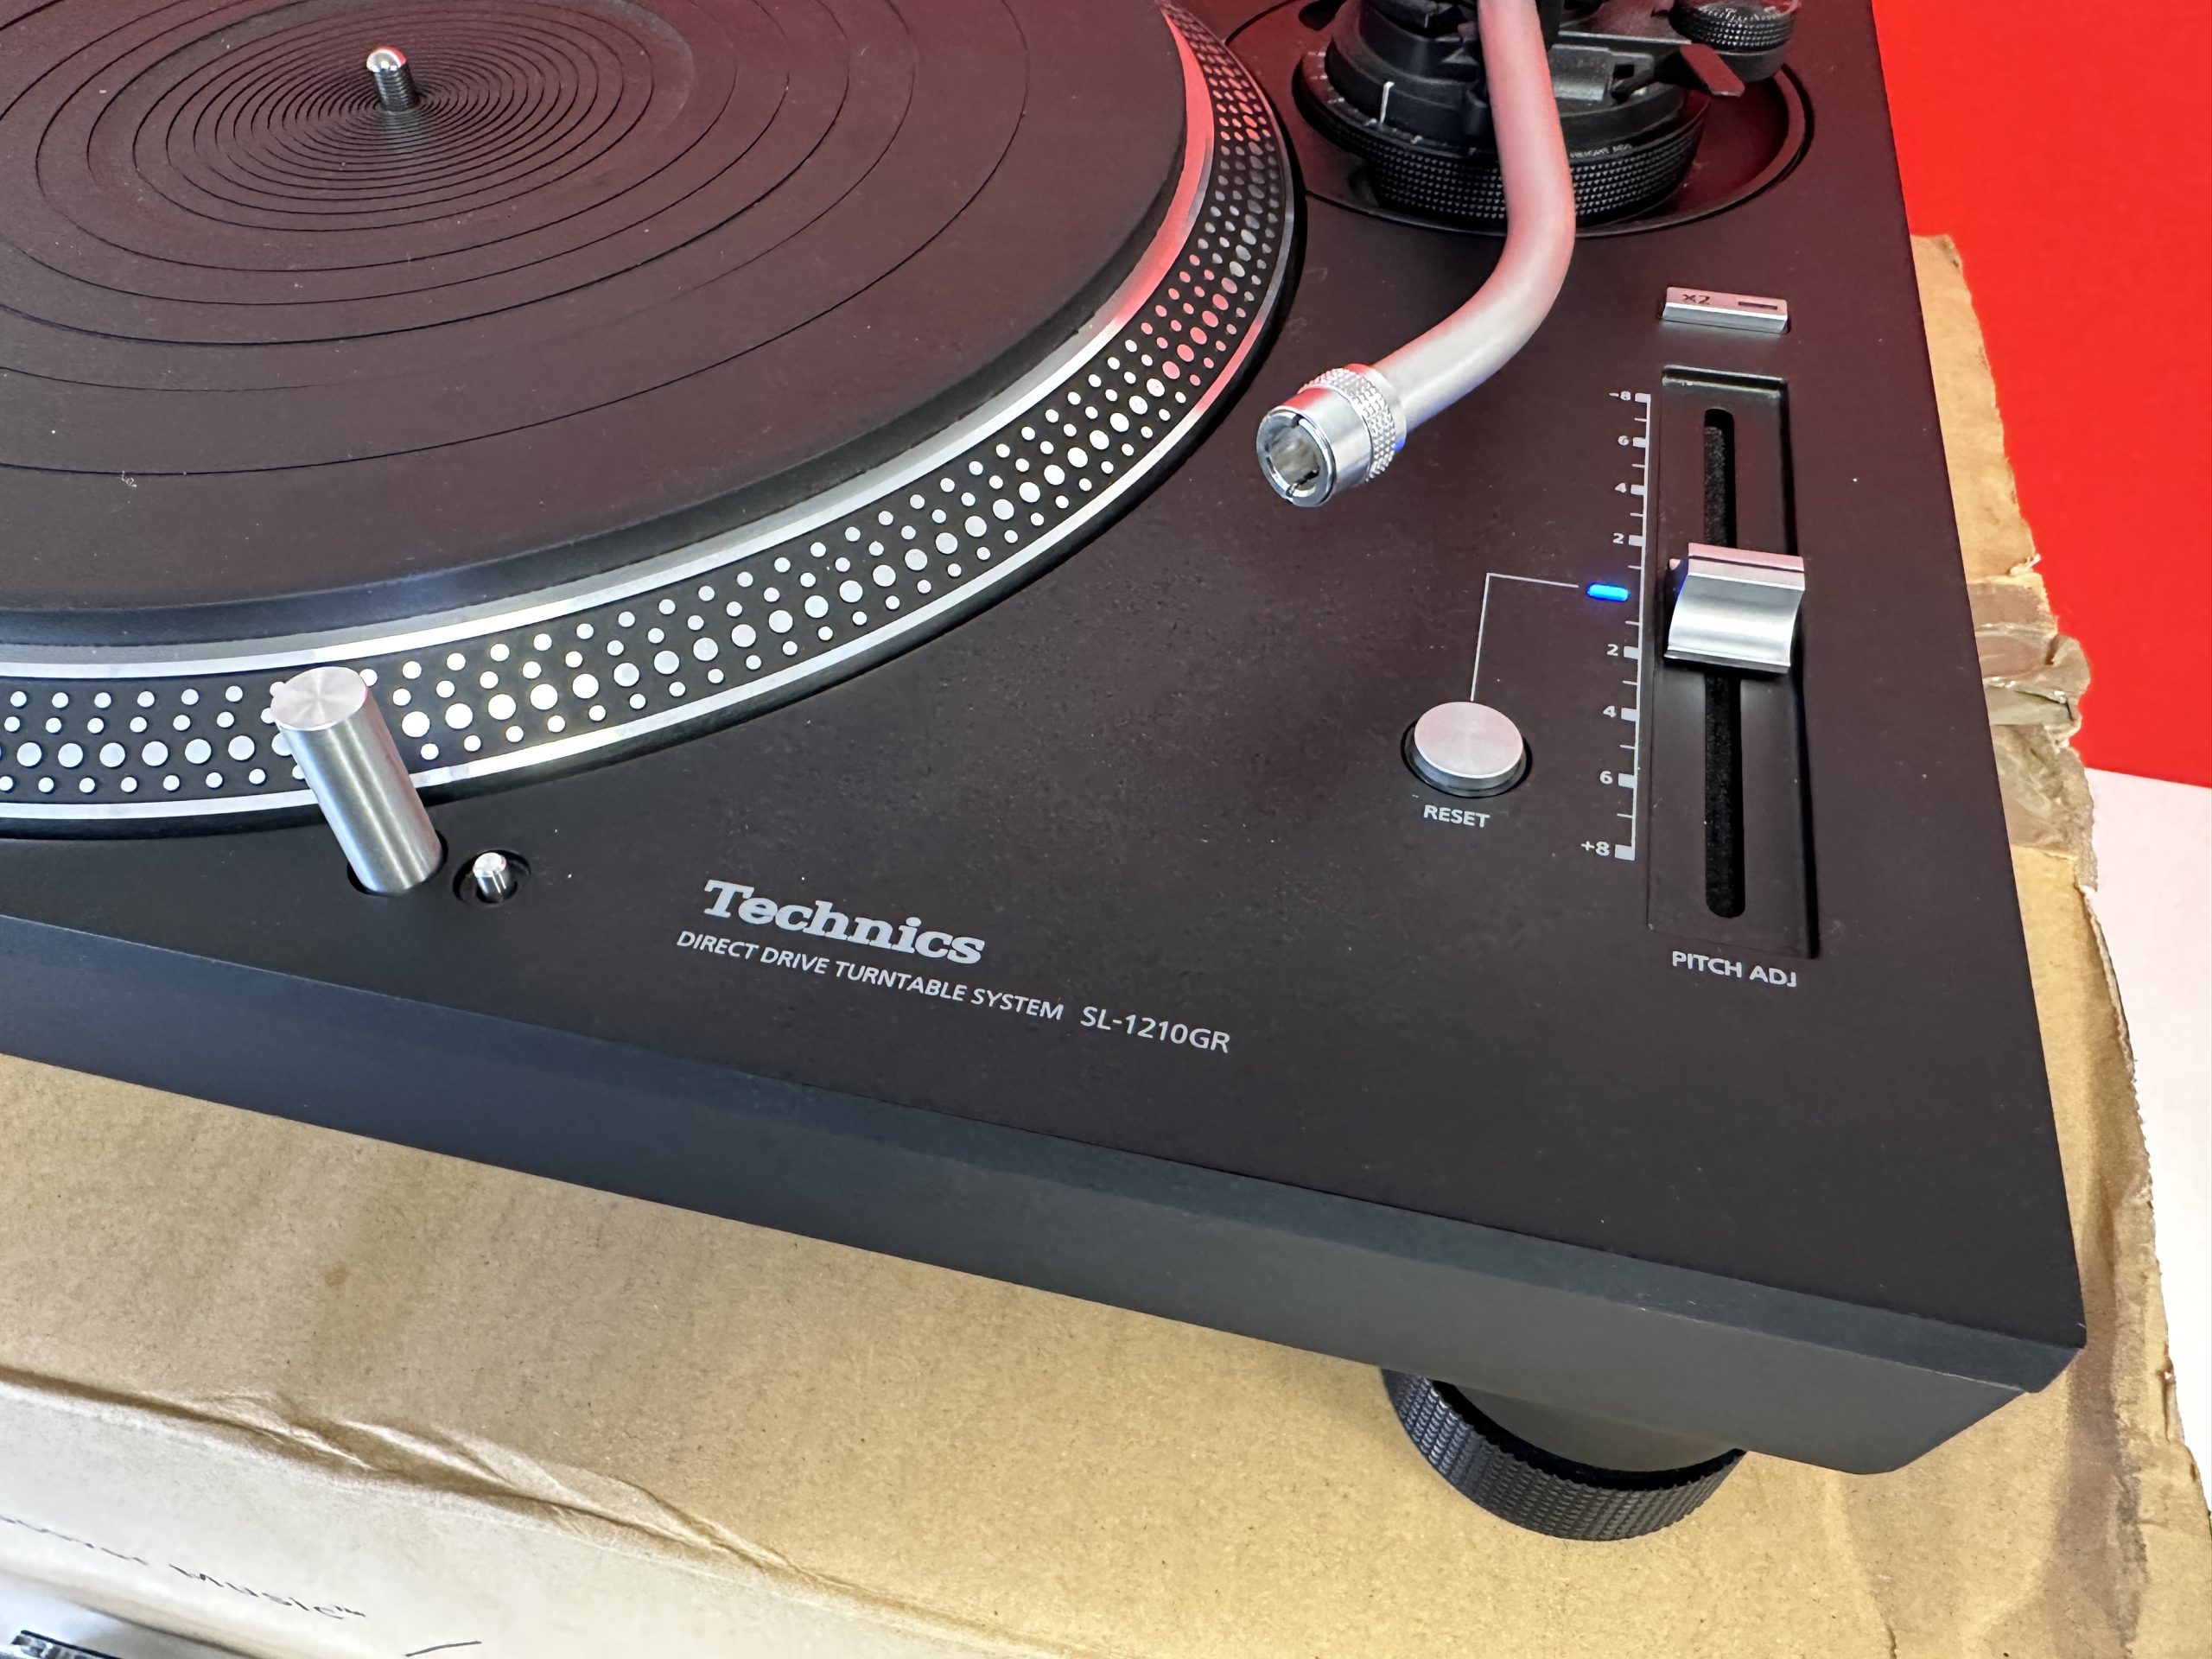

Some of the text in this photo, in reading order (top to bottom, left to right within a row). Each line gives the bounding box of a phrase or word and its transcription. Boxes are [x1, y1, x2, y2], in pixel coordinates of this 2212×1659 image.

[1618, 435, 1630, 447] 6
[1614, 482, 1627, 493] 4
[1612, 532, 1624, 544] 2
[1606, 643, 1619, 657] 2
[1602, 705, 1618, 718] 4
[1599, 770, 1613, 785] 6
[1423, 804, 1491, 829] RESET
[1580, 841, 1611, 857] +8
[703, 879, 986, 965] Technics
[1672, 950, 1798, 988] PITCH ADJ
[676, 930, 1231, 1054] DIRECT DRIVE TURNTABLE SYSTEM SL-1210GR
